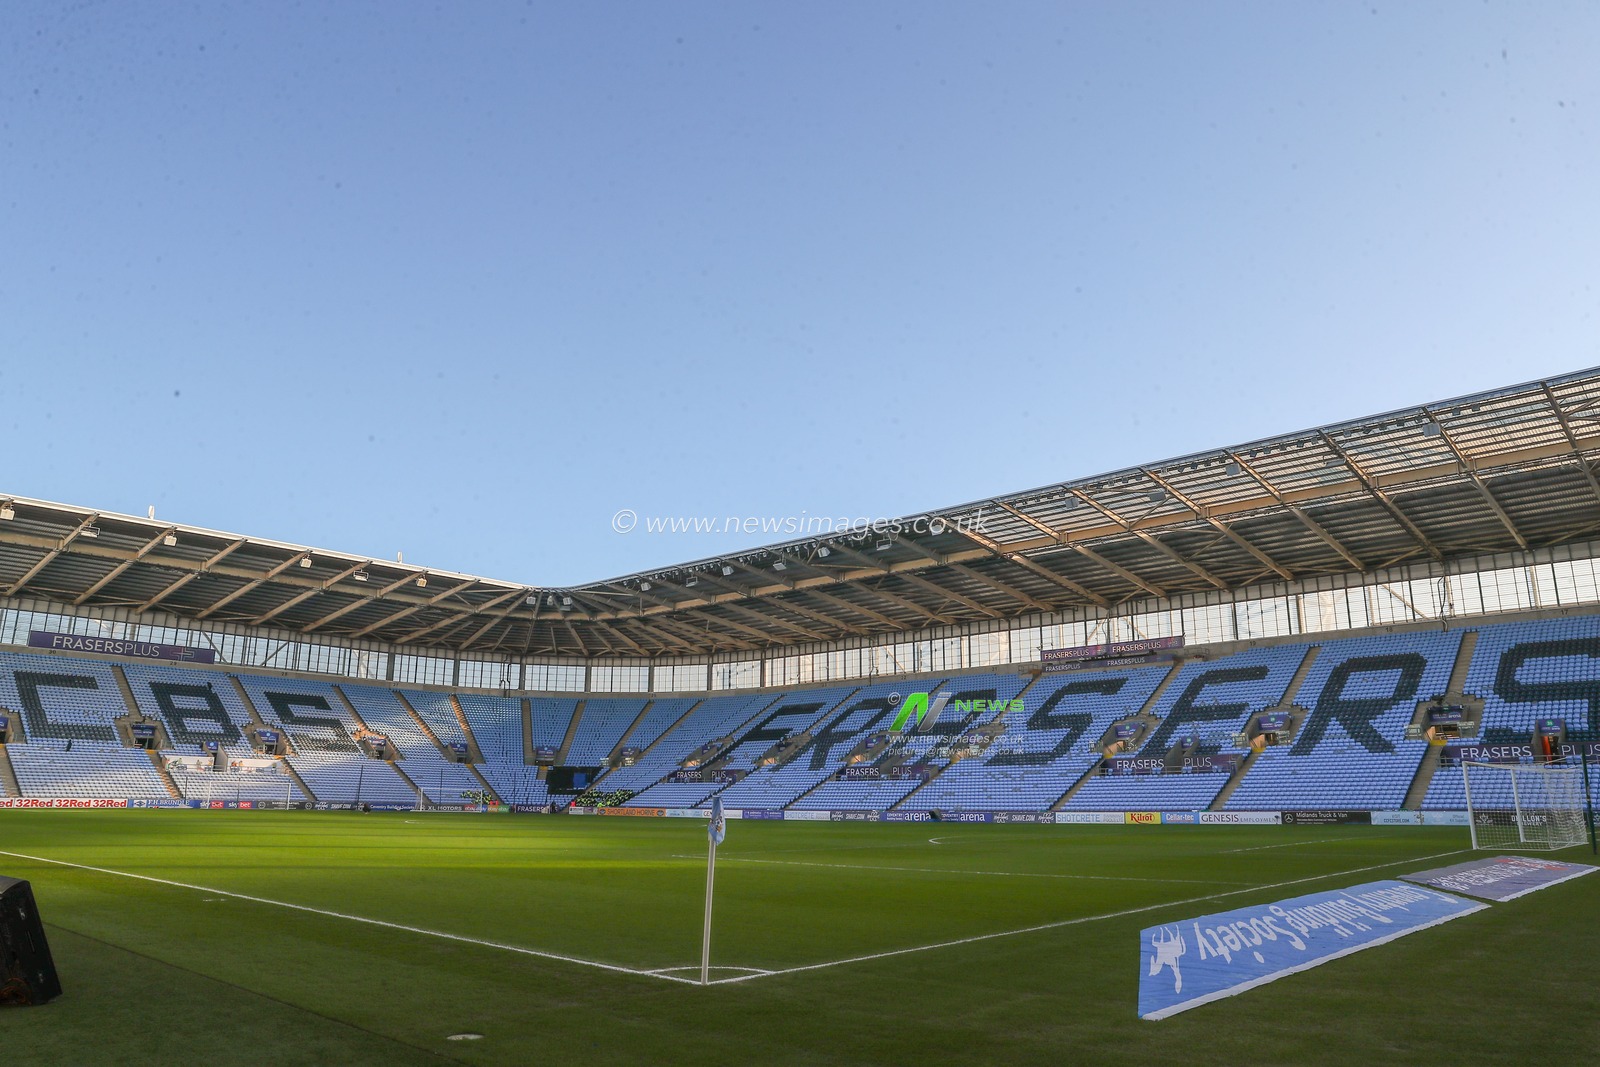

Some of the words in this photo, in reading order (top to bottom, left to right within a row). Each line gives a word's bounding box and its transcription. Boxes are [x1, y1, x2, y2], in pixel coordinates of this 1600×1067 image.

[52, 635, 160, 657] FRASERSPLUS
[1044, 650, 1090, 660] FRASERSPLUS
[1112, 641, 1161, 653] FRASERSPLUS
[1045, 663, 1081, 672] FRASERSPLUS
[1107, 657, 1145, 666] FRASERSPLUS
[1460, 745, 1533, 759] FRASERS
[1116, 758, 1165, 770] FRASERS
[1184, 757, 1212, 768] PLUS
[846, 768, 880, 776] FRASERS
[892, 766, 912, 775] PLUS
[0, 799, 14, 807] ed
[16, 799, 54, 808] 32Red
[55, 799, 92, 808] 32Red
[92, 799, 128, 808] 32Red
[904, 812, 931, 822] arena
[960, 813, 986, 822] arena
[1056, 814, 1101, 823] SHOTCRETE
[1201, 814, 1239, 823] GENESIS
[1193, 916, 1306, 963] Society
